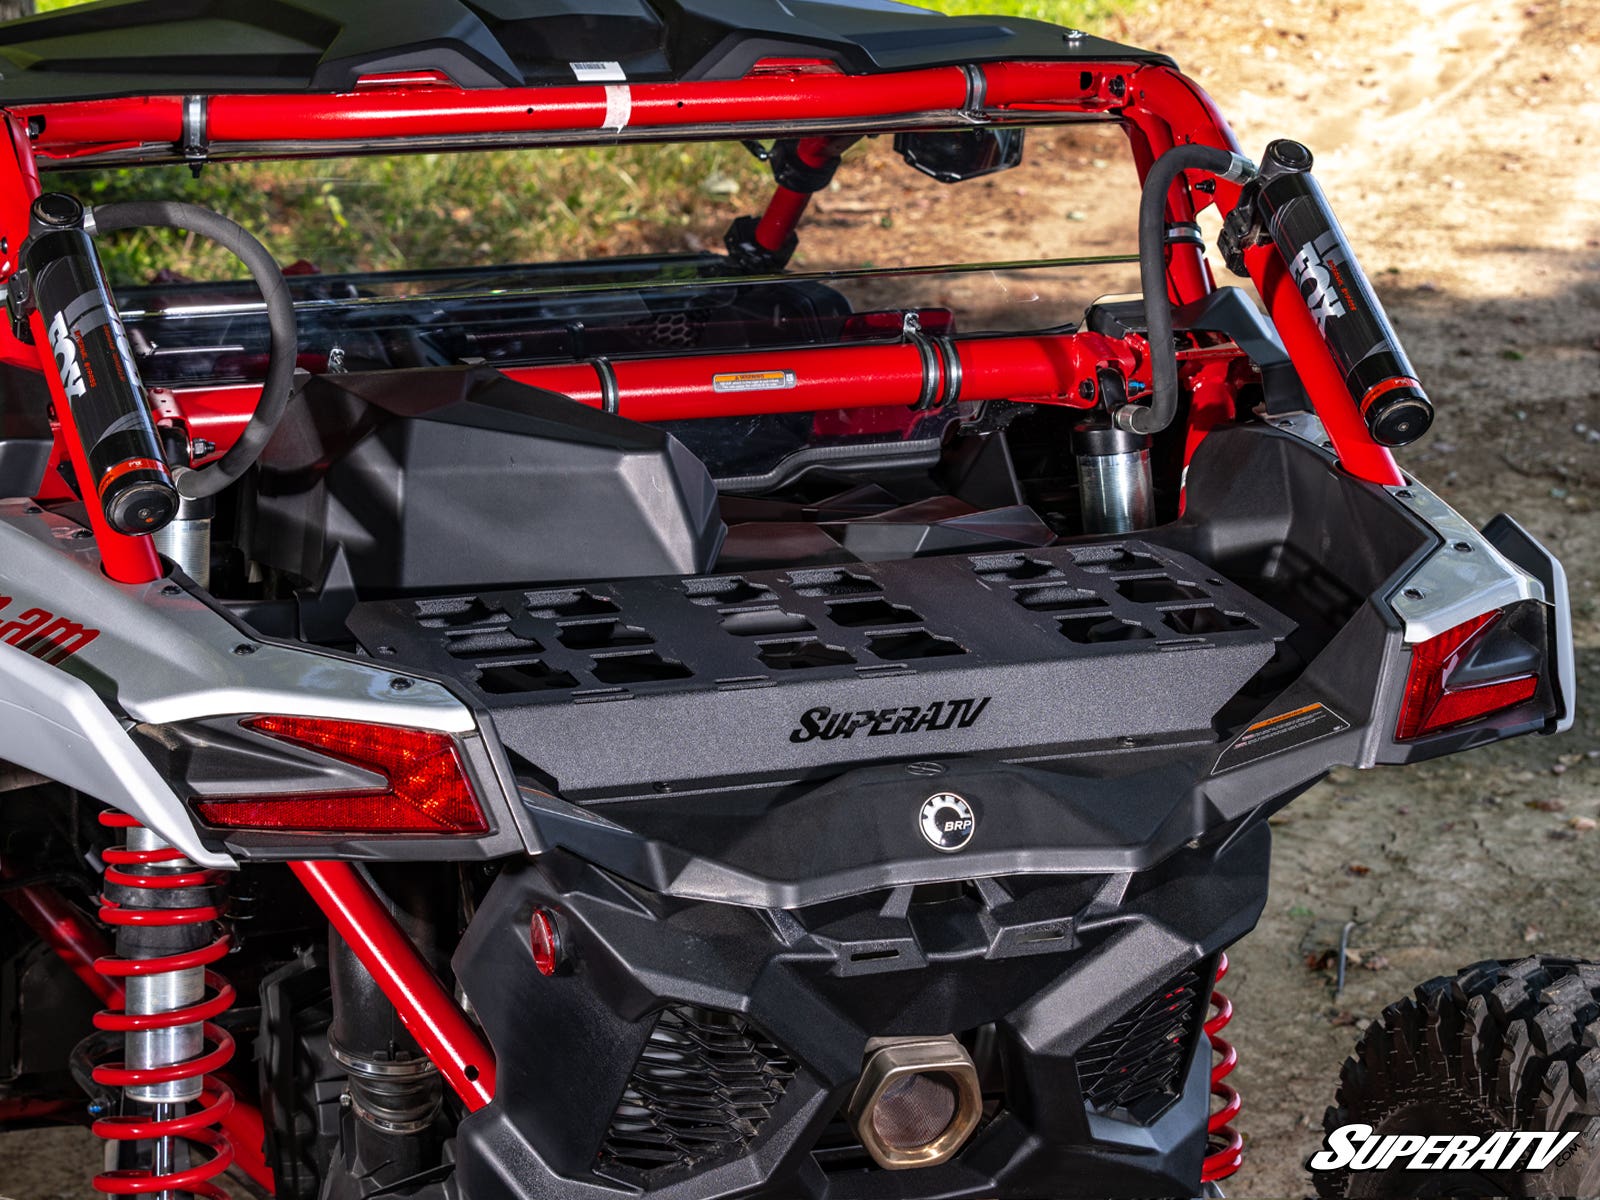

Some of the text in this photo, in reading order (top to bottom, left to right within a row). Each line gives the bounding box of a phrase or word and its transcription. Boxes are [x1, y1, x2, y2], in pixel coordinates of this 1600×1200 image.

[1290, 241, 1346, 339] FOX
[48, 310, 87, 402] FOX
[0, 595, 101, 667] am
[944, 819, 972, 832] BRP
